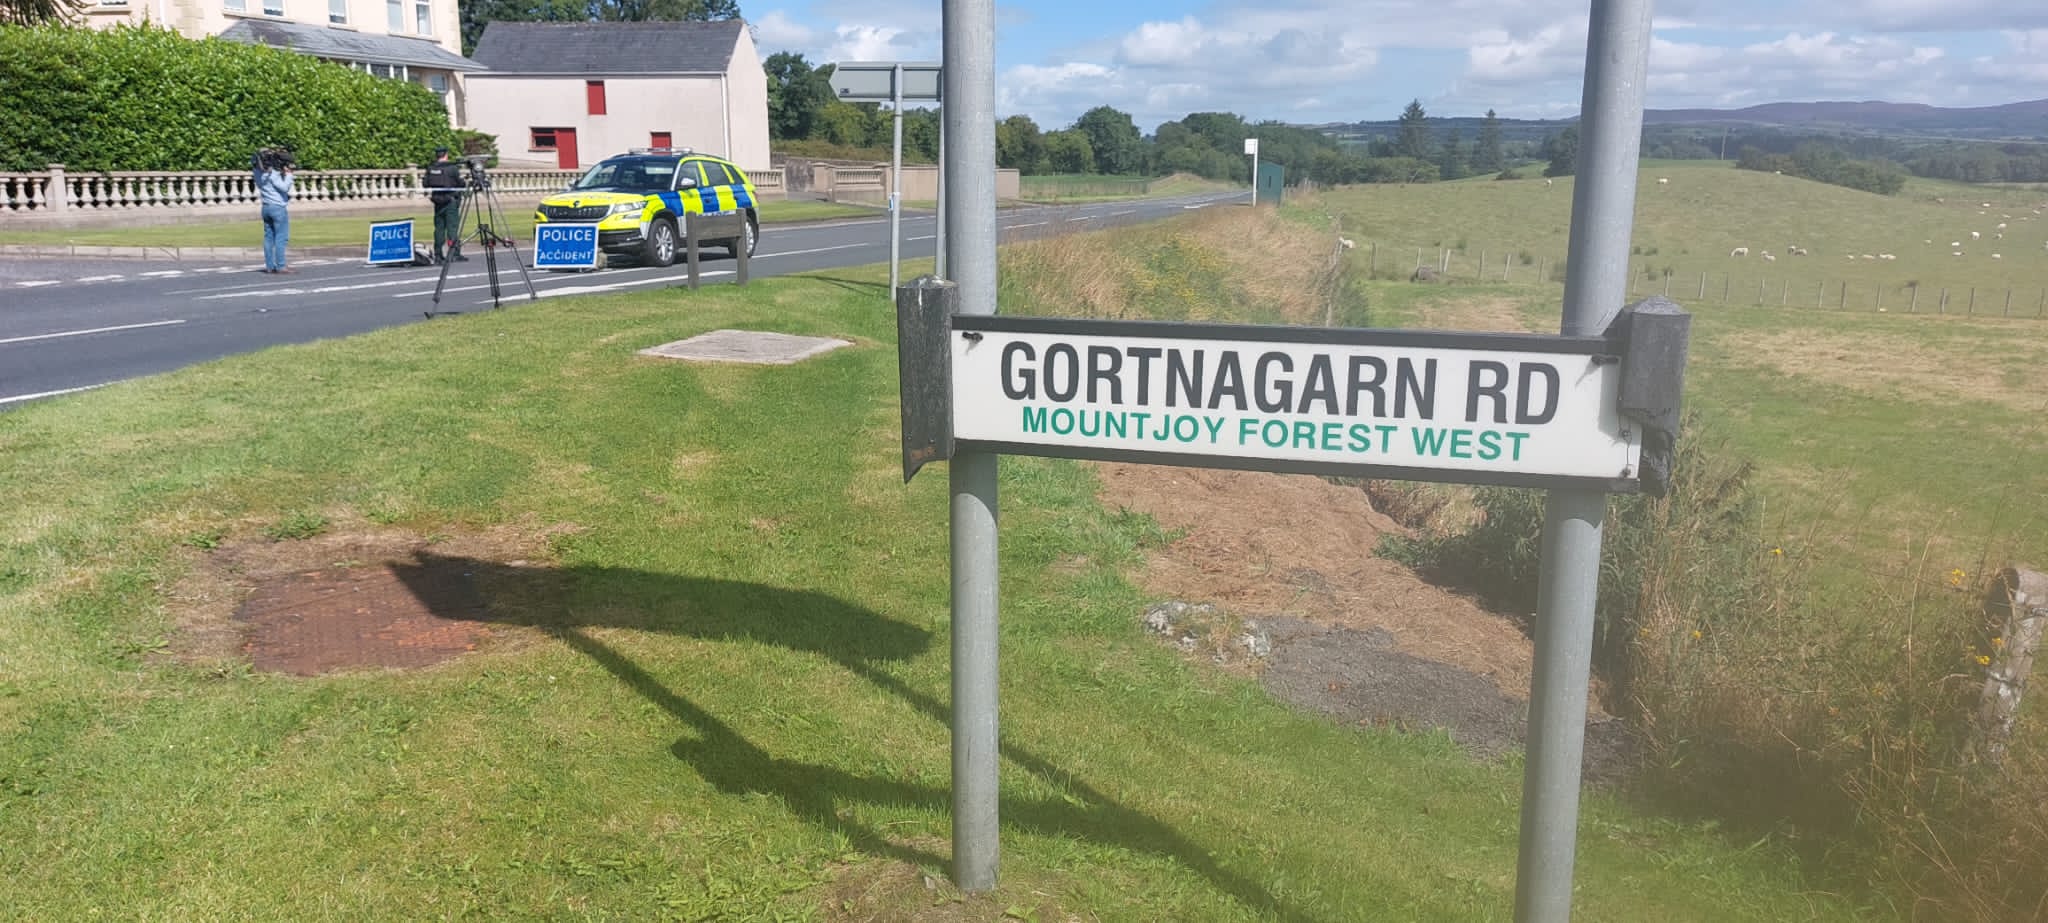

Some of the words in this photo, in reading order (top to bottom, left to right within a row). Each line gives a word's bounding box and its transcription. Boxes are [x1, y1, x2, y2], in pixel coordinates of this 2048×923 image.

[374, 228, 409, 241] POLICE
[542, 229, 592, 241] POLICE
[540, 250, 592, 260] ACCIDENT
[1000, 340, 1437, 420] GORTNAGARN
[1465, 359, 1560, 425] RD
[1023, 406, 1224, 444] MOUNTJOY
[1239, 418, 1397, 453] FOREST
[1412, 428, 1529, 460] WEST
